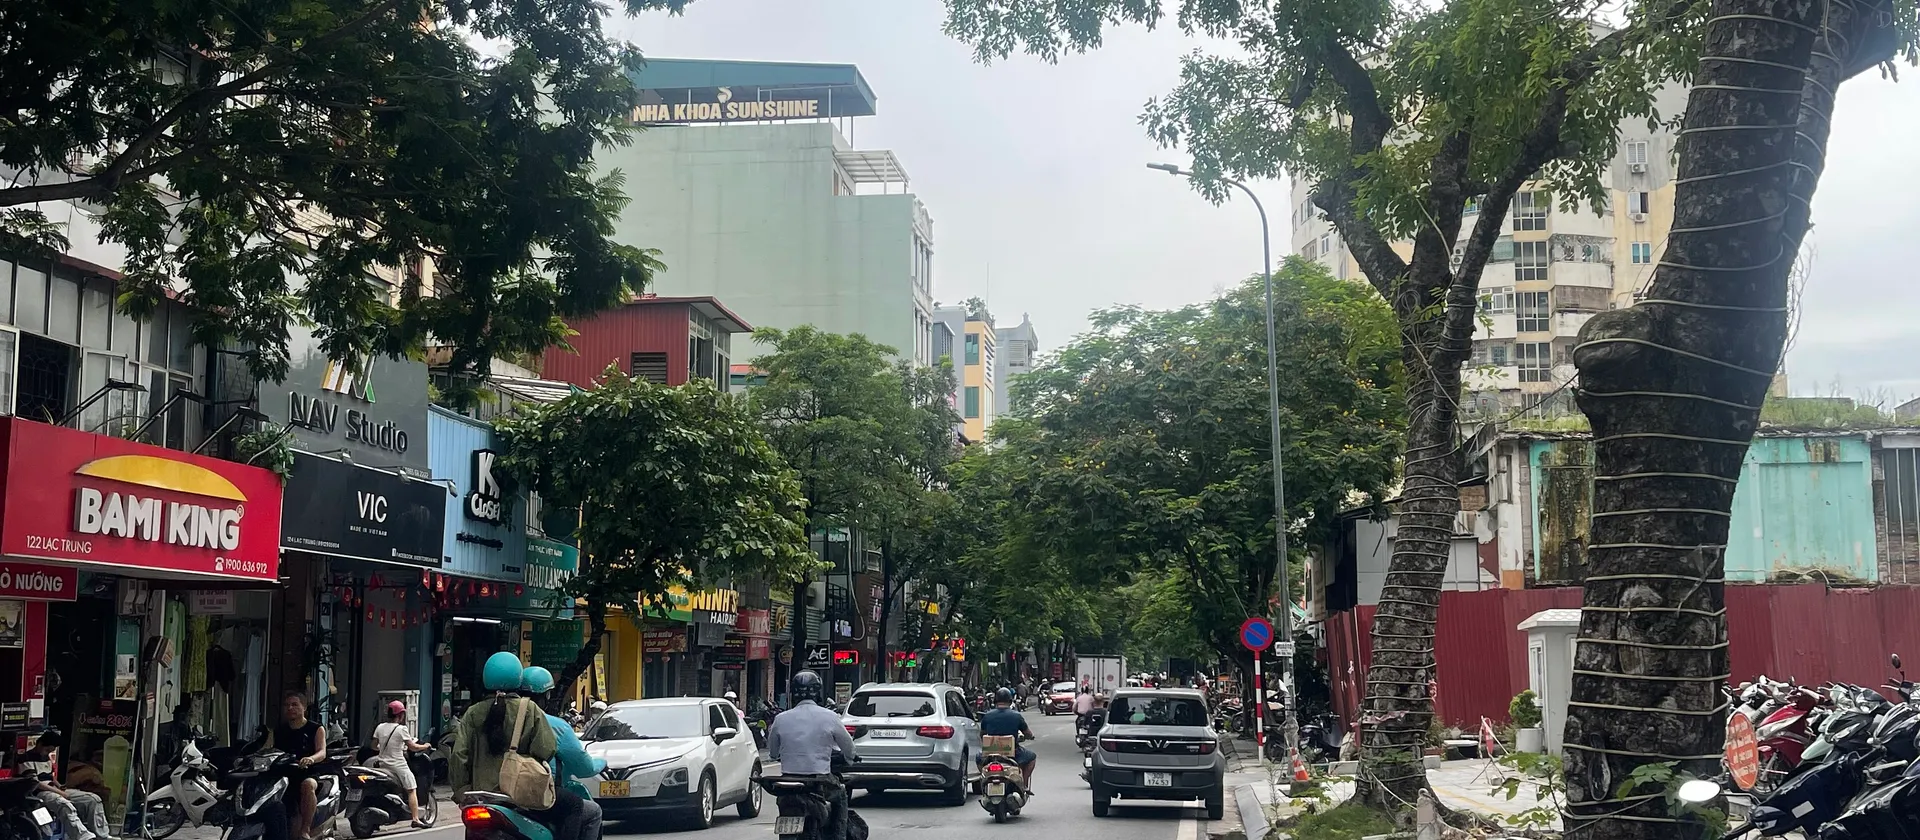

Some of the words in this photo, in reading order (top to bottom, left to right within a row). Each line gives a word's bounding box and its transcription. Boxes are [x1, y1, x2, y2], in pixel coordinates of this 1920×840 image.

[633, 104, 668, 122] NHA
[674, 102, 722, 121] KHOA
[726, 99, 819, 119] SUNSHINE
[288, 391, 339, 434] NAV
[345, 408, 408, 454] Studio
[357, 490, 388, 523] VIC
[77, 487, 163, 542] BAMI
[166, 502, 240, 551] KING
[26, 535, 43, 549] 122
[43, 536, 61, 552] LẠC
[61, 538, 92, 554] TRUNG
[225, 558, 242, 571] 1900
[242, 560, 255, 573] 636
[256, 562, 268, 574] 912
[15, 571, 63, 592] NƯỚNG
[106, 714, 133, 728] 20%
